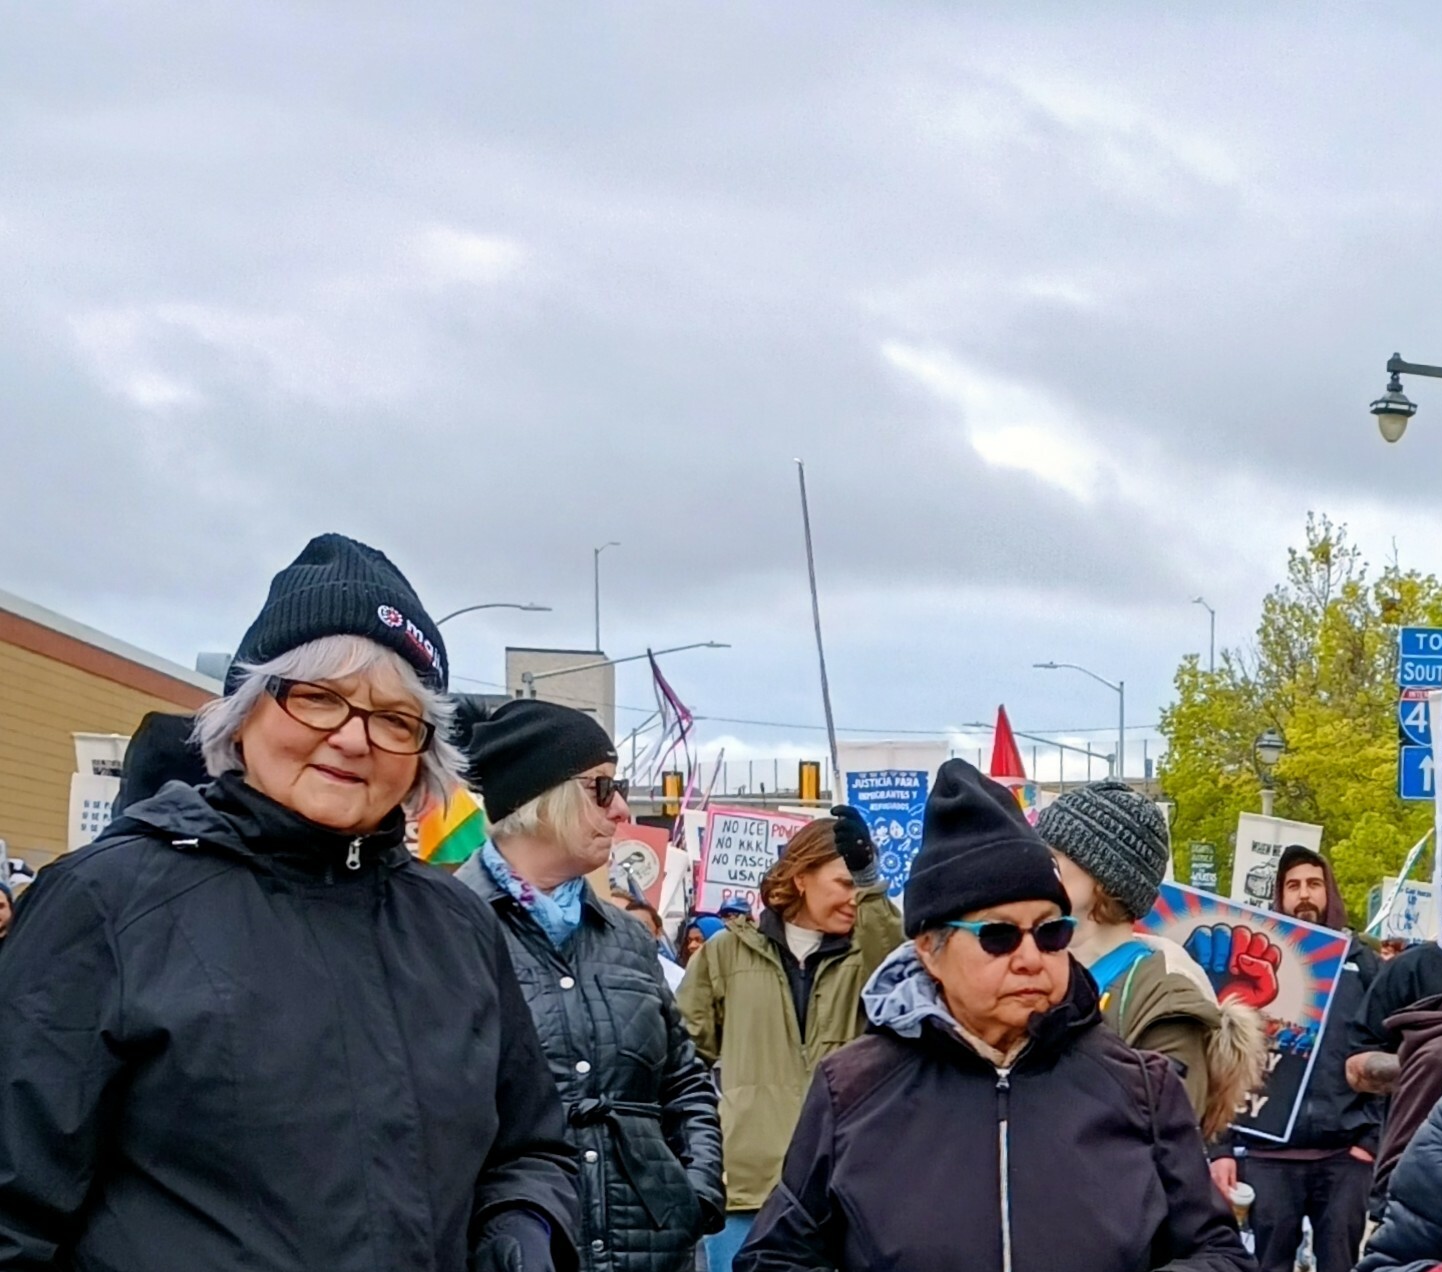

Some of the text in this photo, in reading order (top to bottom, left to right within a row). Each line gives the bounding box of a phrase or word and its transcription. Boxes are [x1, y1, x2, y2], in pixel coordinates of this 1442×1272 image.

[1415, 633, 1442, 651] TO
[852, 777, 920, 789] JUSTICIA PARA
[912, 791, 918, 799] Y
[723, 820, 765, 836] NO ICE
[716, 836, 763, 853] NO KKK
[712, 853, 729, 865] NO
[728, 869, 756, 882] USA
